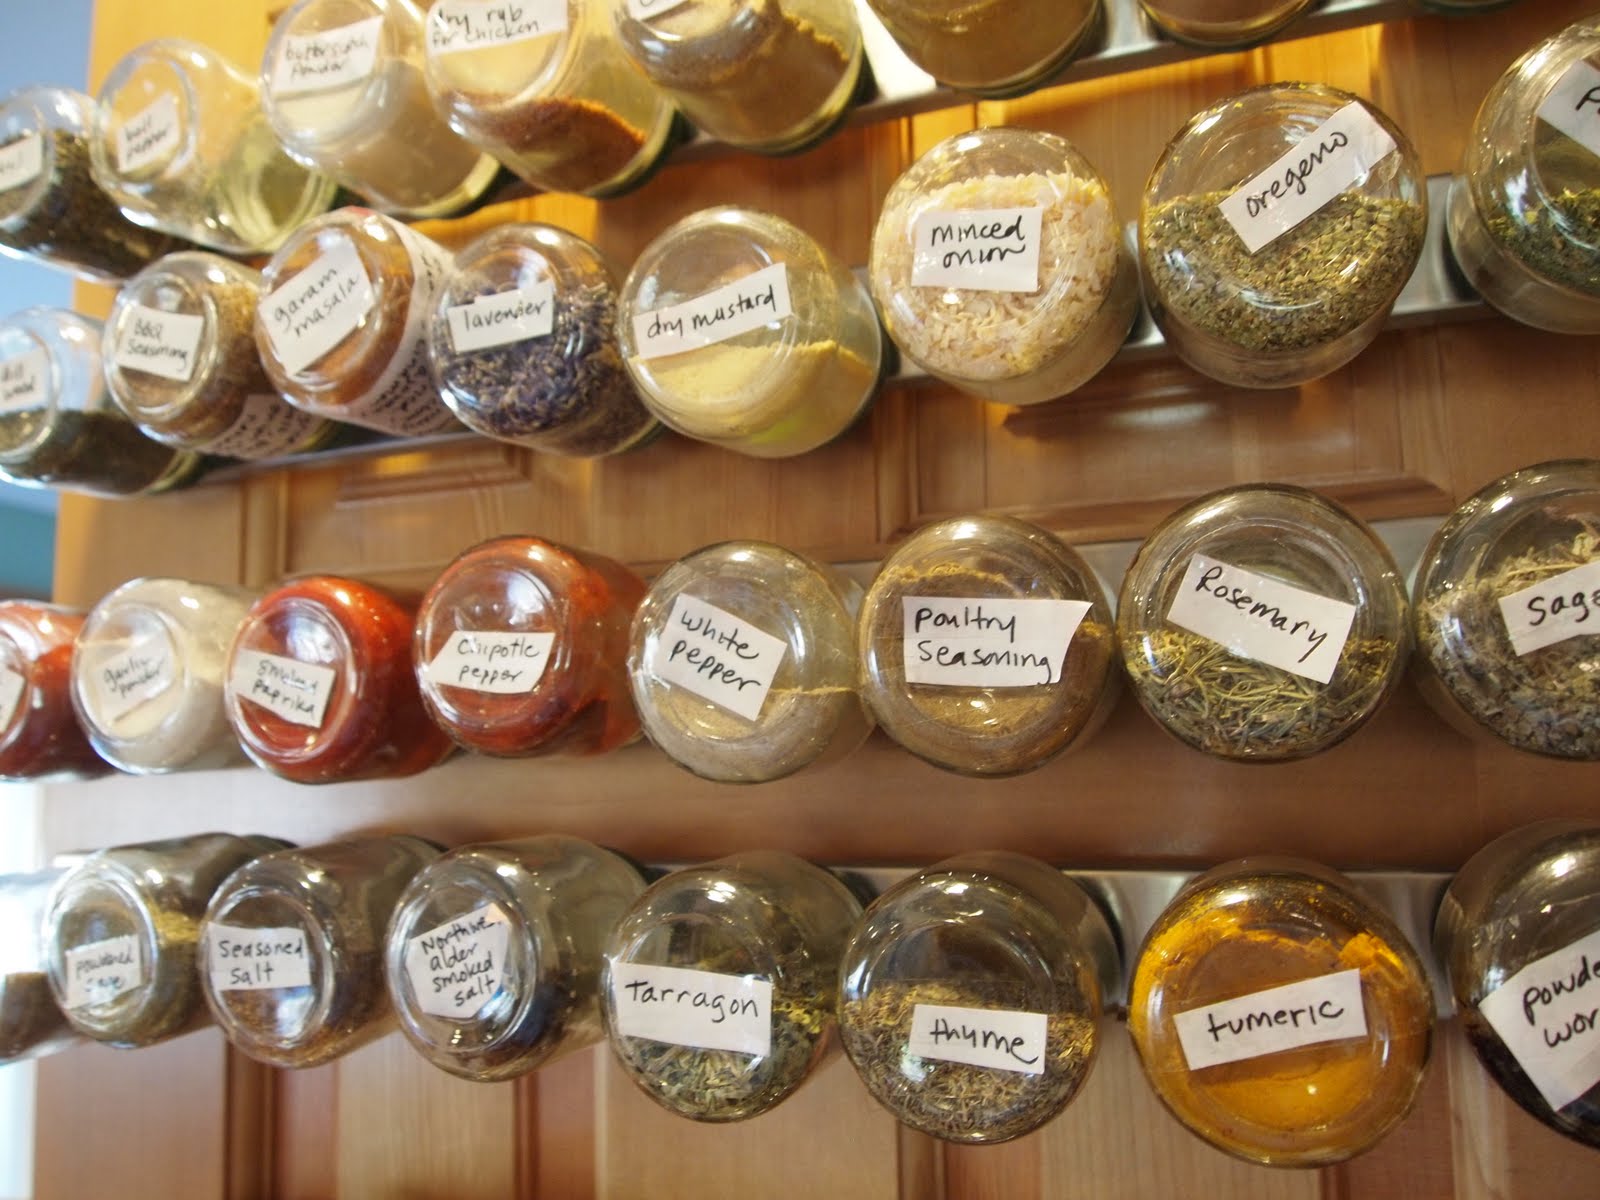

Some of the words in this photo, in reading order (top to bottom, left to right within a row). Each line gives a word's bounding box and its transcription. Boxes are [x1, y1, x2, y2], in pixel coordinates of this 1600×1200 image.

[464, 20, 540, 41] chicken
[486, 3, 523, 35] rub
[274, 268, 337, 336] garam
[464, 298, 547, 333] lavender
[645, 315, 684, 340] dry
[692, 286, 777, 331] mustard
[1195, 566, 1329, 664] Rosemary
[458, 659, 523, 685] pepper
[669, 639, 762, 694] pepper
[430, 943, 479, 971] alder
[929, 1017, 1039, 1066] thyme
[1207, 999, 1345, 1043] tumeric
